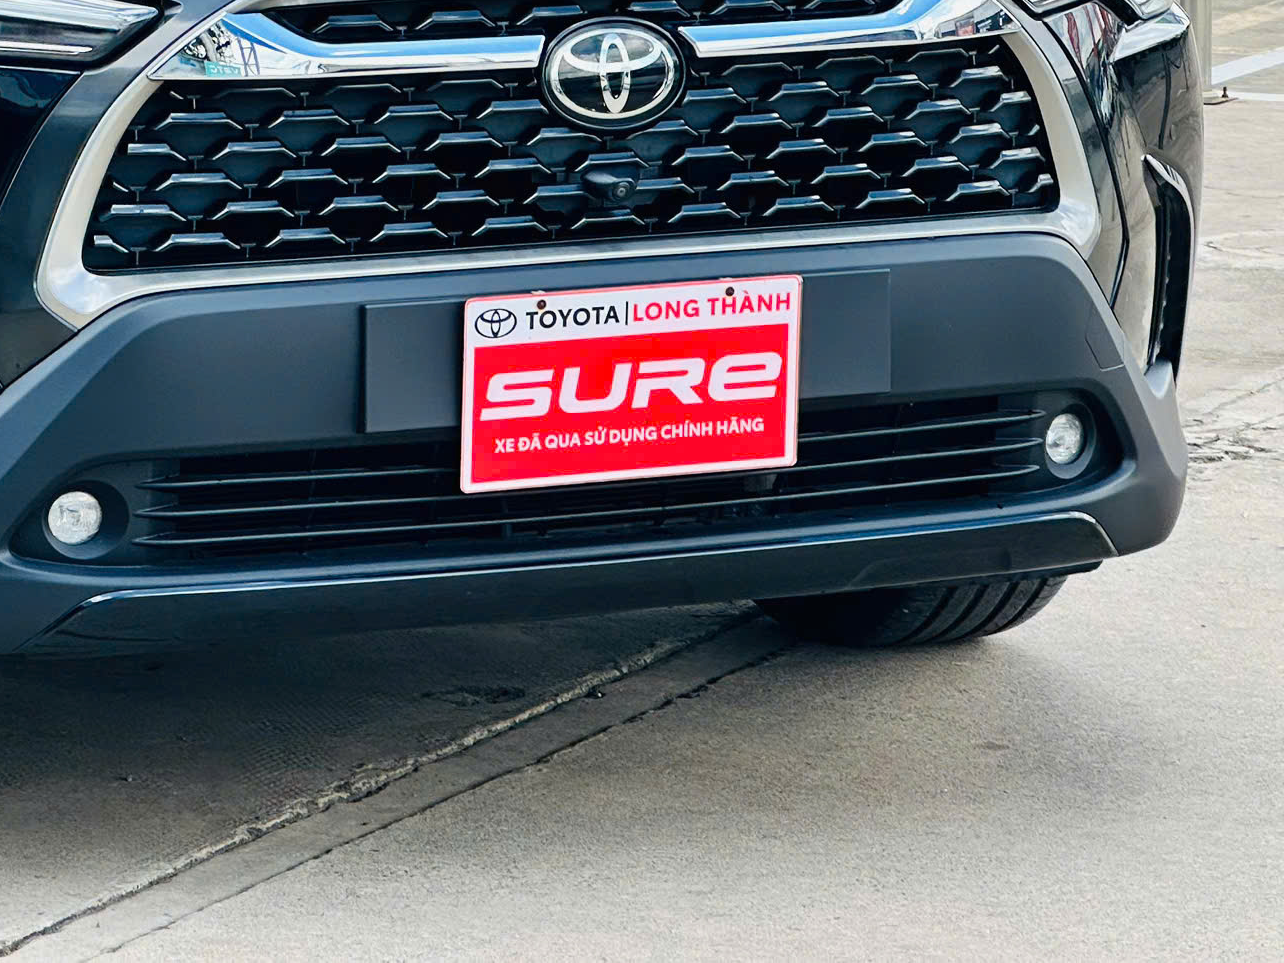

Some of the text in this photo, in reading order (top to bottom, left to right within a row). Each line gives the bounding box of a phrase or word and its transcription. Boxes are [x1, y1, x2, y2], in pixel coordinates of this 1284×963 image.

[526, 290, 791, 330] TOYOTA LONG THÀNH
[495, 417, 765, 453] XE ĐÃ QUA SỬ DỤNG CHÍNH HÃNG
